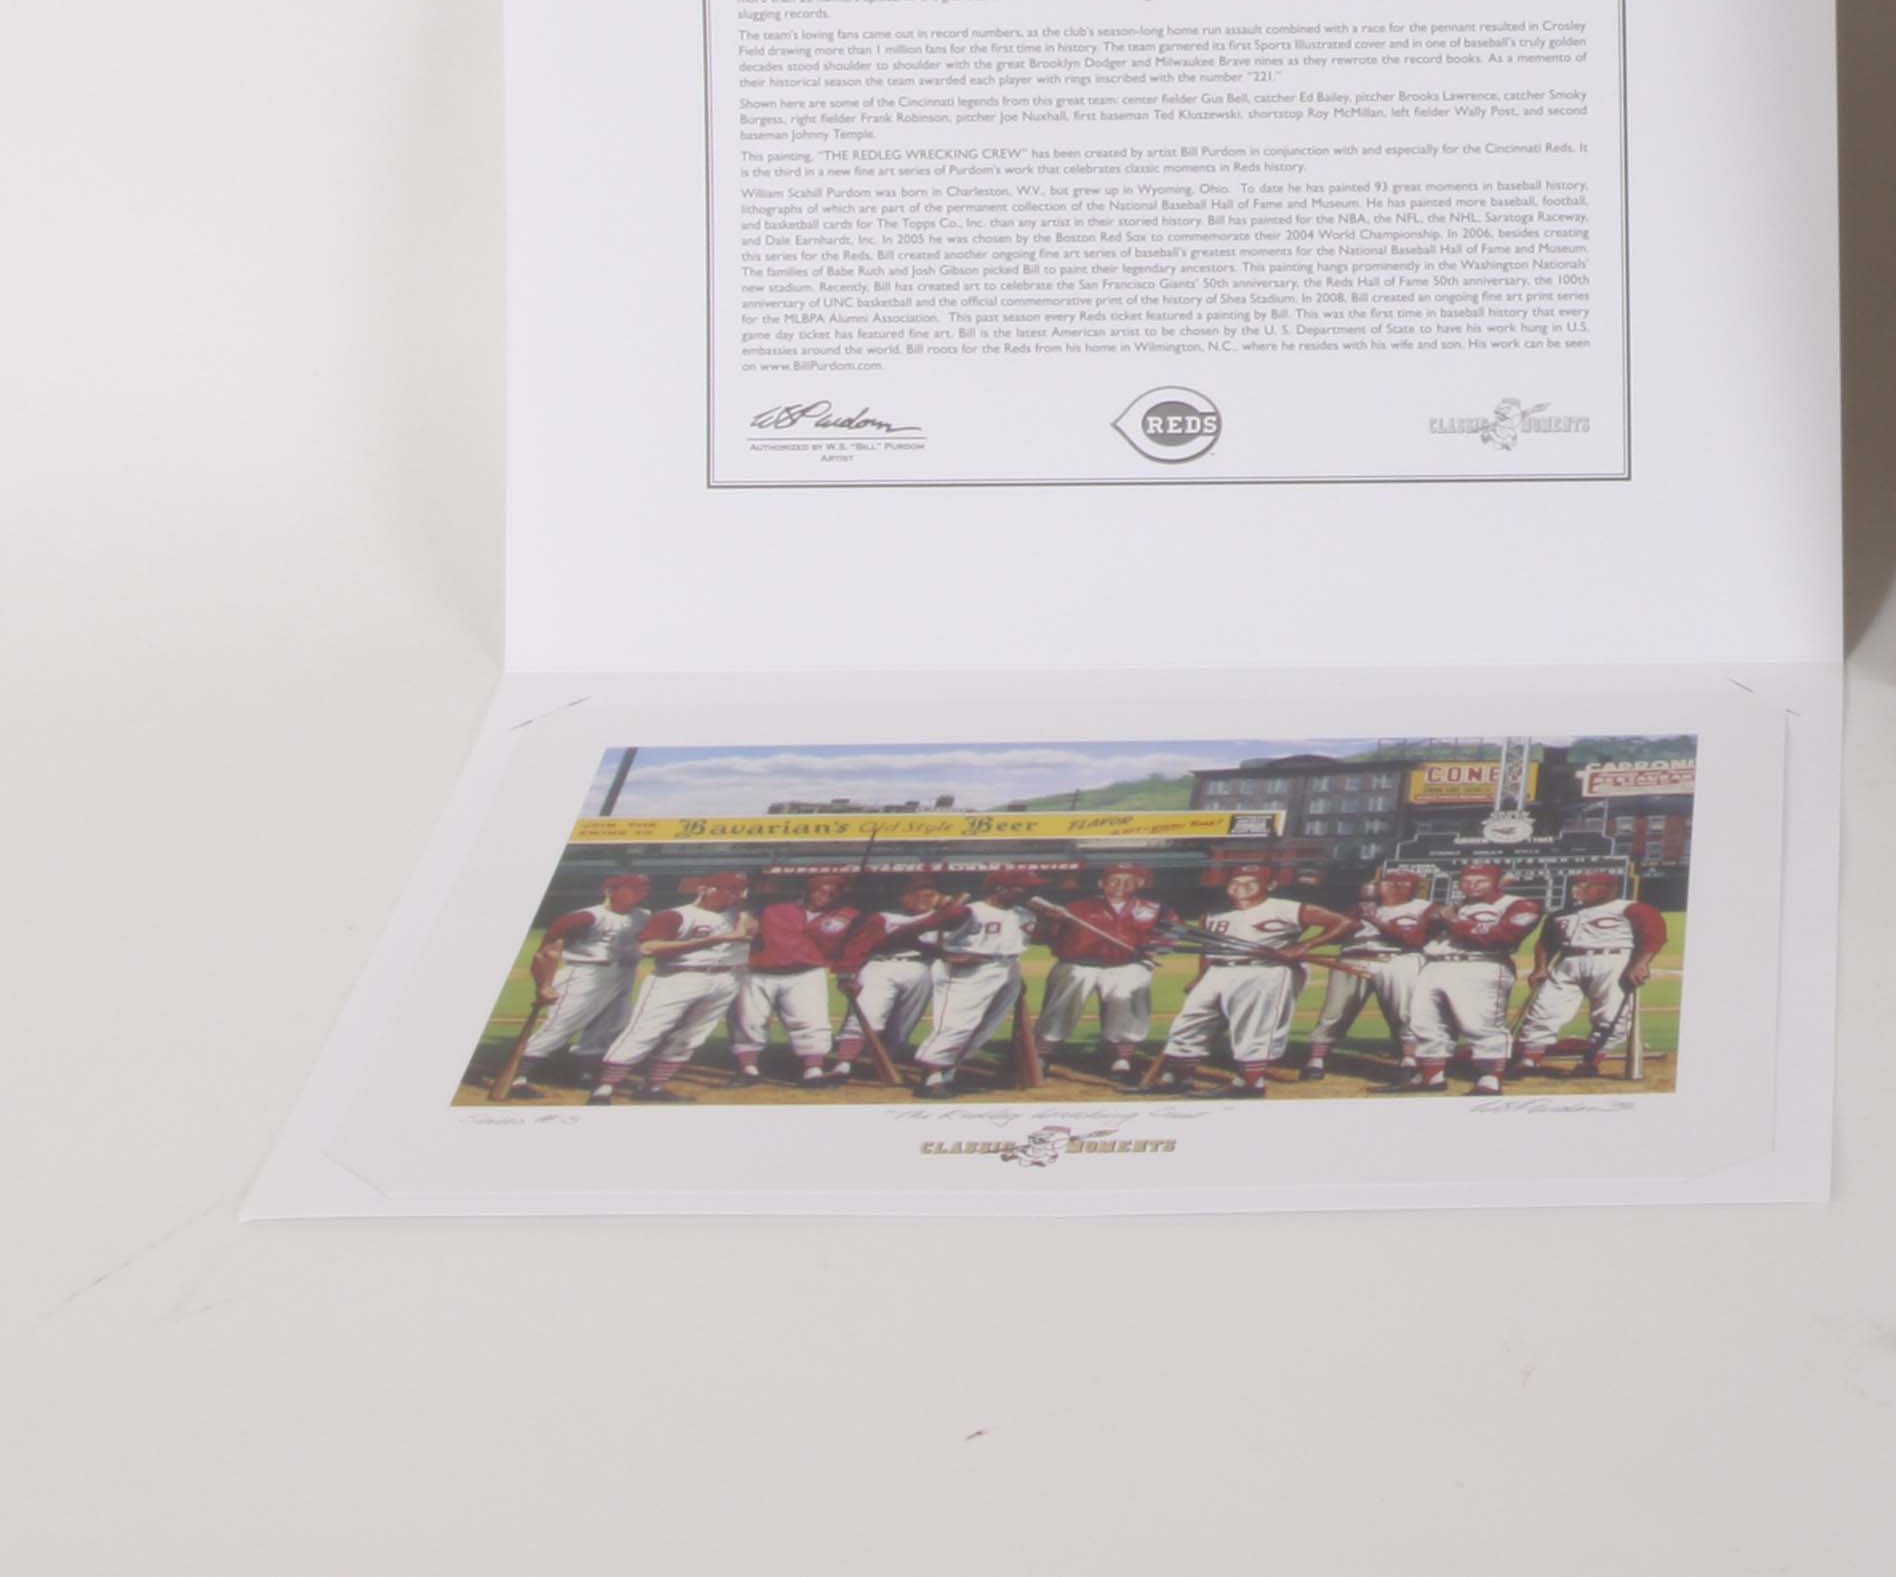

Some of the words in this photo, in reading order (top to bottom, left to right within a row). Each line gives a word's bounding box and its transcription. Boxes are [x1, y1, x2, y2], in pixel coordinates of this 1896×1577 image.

[738, 10, 781, 22] slugging
[739, 77, 765, 88] their
[769, 77, 820, 87] historical
[824, 79, 862, 87] season
[865, 75, 884, 87] the
[886, 77, 915, 86] team
[918, 74, 966, 86] awarded
[969, 74, 996, 86] each
[998, 74, 1032, 87] player
[1036, 73, 1062, 84] with
[1064, 75, 1092, 87] rings
[1095, 73, 1146, 84] inscribed
[1149, 71, 1175, 82] with
[1177, 71, 1196, 83] the
[1199, 71, 1242, 82] number
[739, 97, 777, 109] Shown
[780, 99, 805, 108] here
[808, 100, 826, 108] are
[829, 100, 859, 108] some
[862, 96, 874, 108] of
[876, 97, 895, 107] the
[898, 95, 954, 107] Cincinnati
[957, 96, 1000, 109] legends
[1002, 95, 1030, 106] from
[1032, 95, 1053, 106] this
[1055, 96, 1085, 108] great
[1121, 96, 1158, 105] center
[1161, 93, 1197, 105] fielder
[1200, 92, 1224, 104] Gus
[1254, 93, 1296, 103] catcher
[1299, 91, 1314, 103] Ed
[1355, 91, 1395, 105] pitcher
[1398, 90, 1440, 102] Brooks
[1503, 90, 1545, 101] catcher
[1548, 88, 1586, 102] Smoky
[740, 130, 788, 140] baseman
[791, 128, 829, 142] Johnny
[741, 150, 764, 162] This
[852, 149, 902, 161] REDLEG
[905, 148, 978, 161] WRECKING
[1031, 149, 1050, 159] has
[1052, 148, 1081, 159] been
[1083, 148, 1127, 159] created
[1130, 147, 1143, 160] by
[1146, 149, 1176, 158] artist
[1180, 146, 1198, 158] Bill
[1201, 145, 1246, 157] Purdom
[1250, 148, 1260, 156] in
[1263, 147, 1330, 158] conjunction
[1333, 145, 1358, 155] with
[1362, 144, 1382, 155] and
[1384, 144, 1438, 157] especially
[1442, 143, 1458, 154] for
[1462, 143, 1481, 154] the
[1484, 142, 1542, 154] Cincinnati
[1579, 143, 1588, 152] It
[740, 169, 749, 177] is
[752, 167, 771, 177] the
[774, 167, 801, 177] third
[804, 166, 815, 176] in
[818, 168, 824, 176] a
[827, 168, 850, 176] new
[854, 165, 875, 176] fine
[878, 167, 894, 176] art
[898, 167, 930, 176] series
[933, 164, 946, 175] of
[1004, 164, 1033, 175] work
[1037, 163, 1060, 175] that
[1063, 163, 1121, 174] celebrates
[1124, 163, 1160, 174] classic
[1163, 164, 1216, 173] moments
[1220, 164, 1230, 172] in
[1233, 160, 1260, 172] Reds
[1145, 415, 1218, 435] REDS
